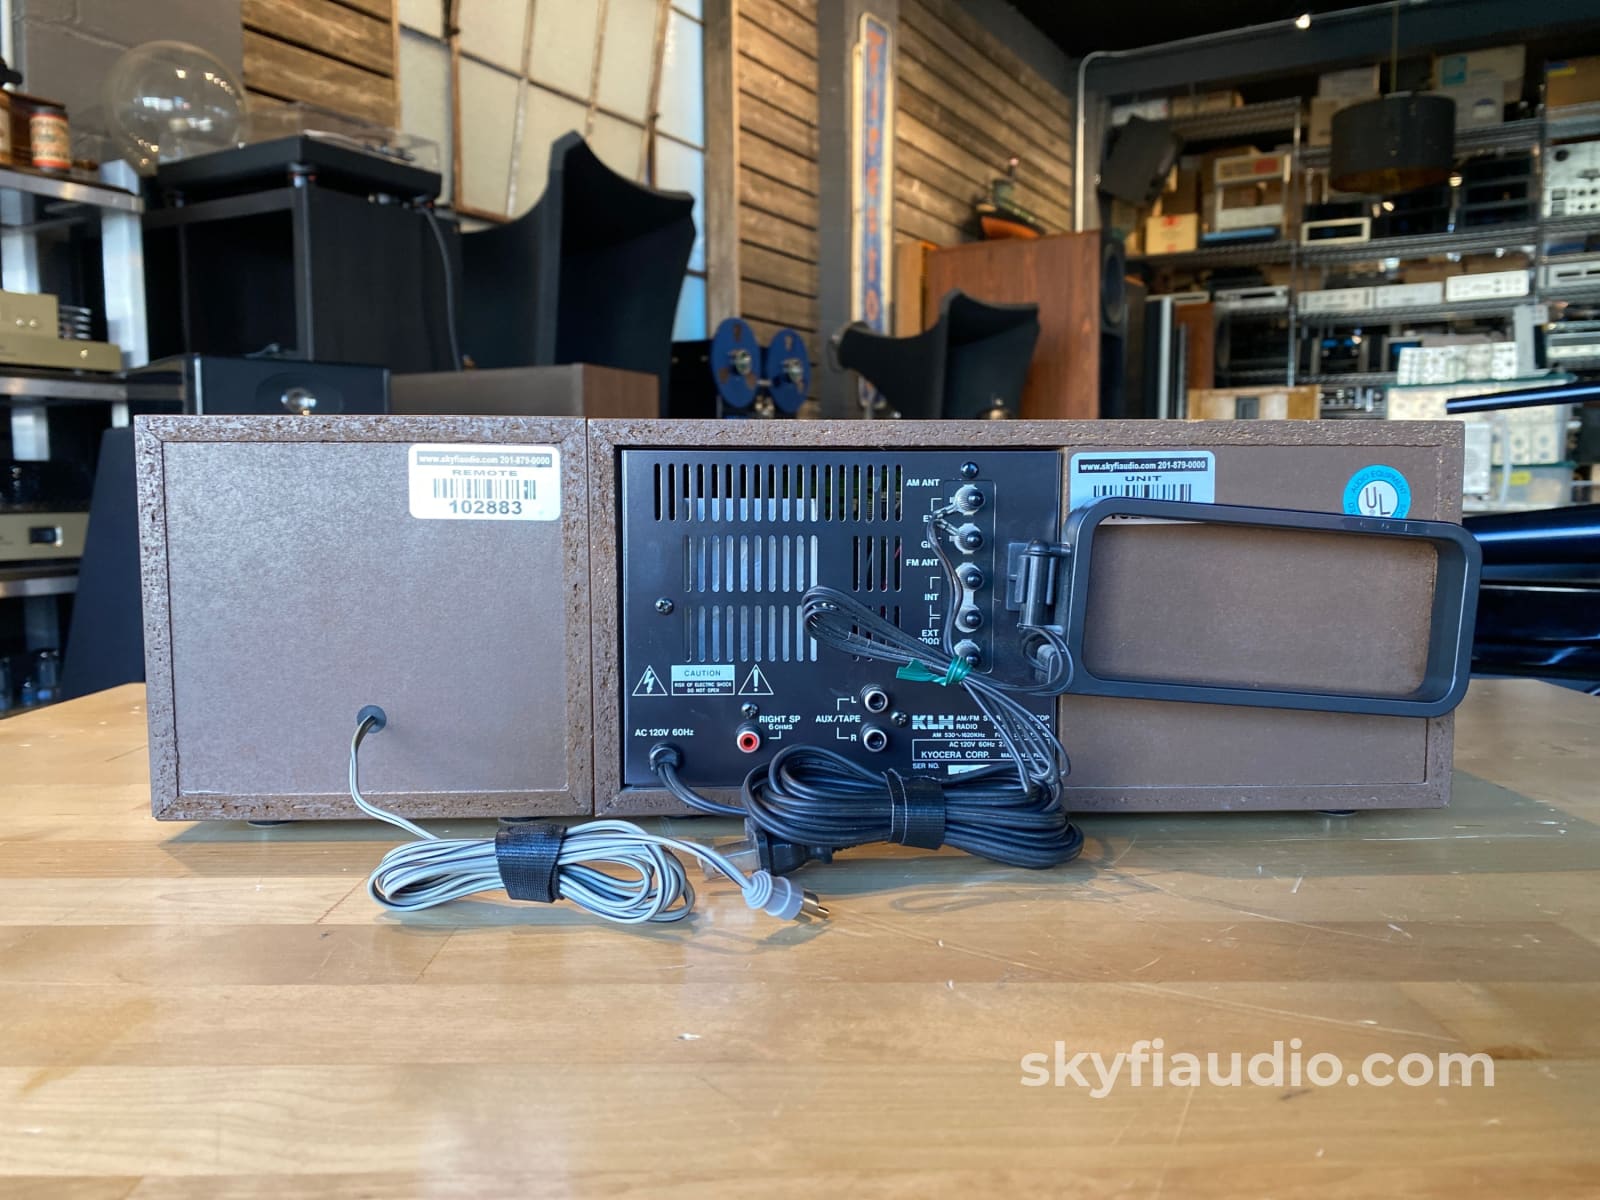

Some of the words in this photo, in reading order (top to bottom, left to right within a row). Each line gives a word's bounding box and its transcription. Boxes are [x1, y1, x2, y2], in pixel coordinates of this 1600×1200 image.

[418, 455, 499, 465] www.skyfiaudio.com
[1080, 461, 1156, 472] www.skyfiaudio.com
[1157, 461, 1206, 469] 201-879-0000
[452, 469, 518, 477] REMOTE
[906, 478, 919, 487] AM
[921, 478, 940, 487] ANT
[1365, 486, 1391, 515] UL
[449, 500, 522, 515] 102883
[906, 558, 919, 567] FM
[921, 558, 940, 567] ANT
[924, 593, 940, 601] INT
[921, 629, 940, 637] EXT
[759, 715, 786, 723] RIGHT
[788, 715, 801, 723] SP
[815, 715, 862, 723] AUX/TAPE
[911, 714, 954, 730] KLH
[634, 729, 648, 737] AC
[649, 729, 670, 737] 120V
[672, 729, 695, 737] 60Hz
[850, 734, 857, 742] R
[921, 751, 962, 759] KYOCERA
[965, 751, 990, 759] CORP.
